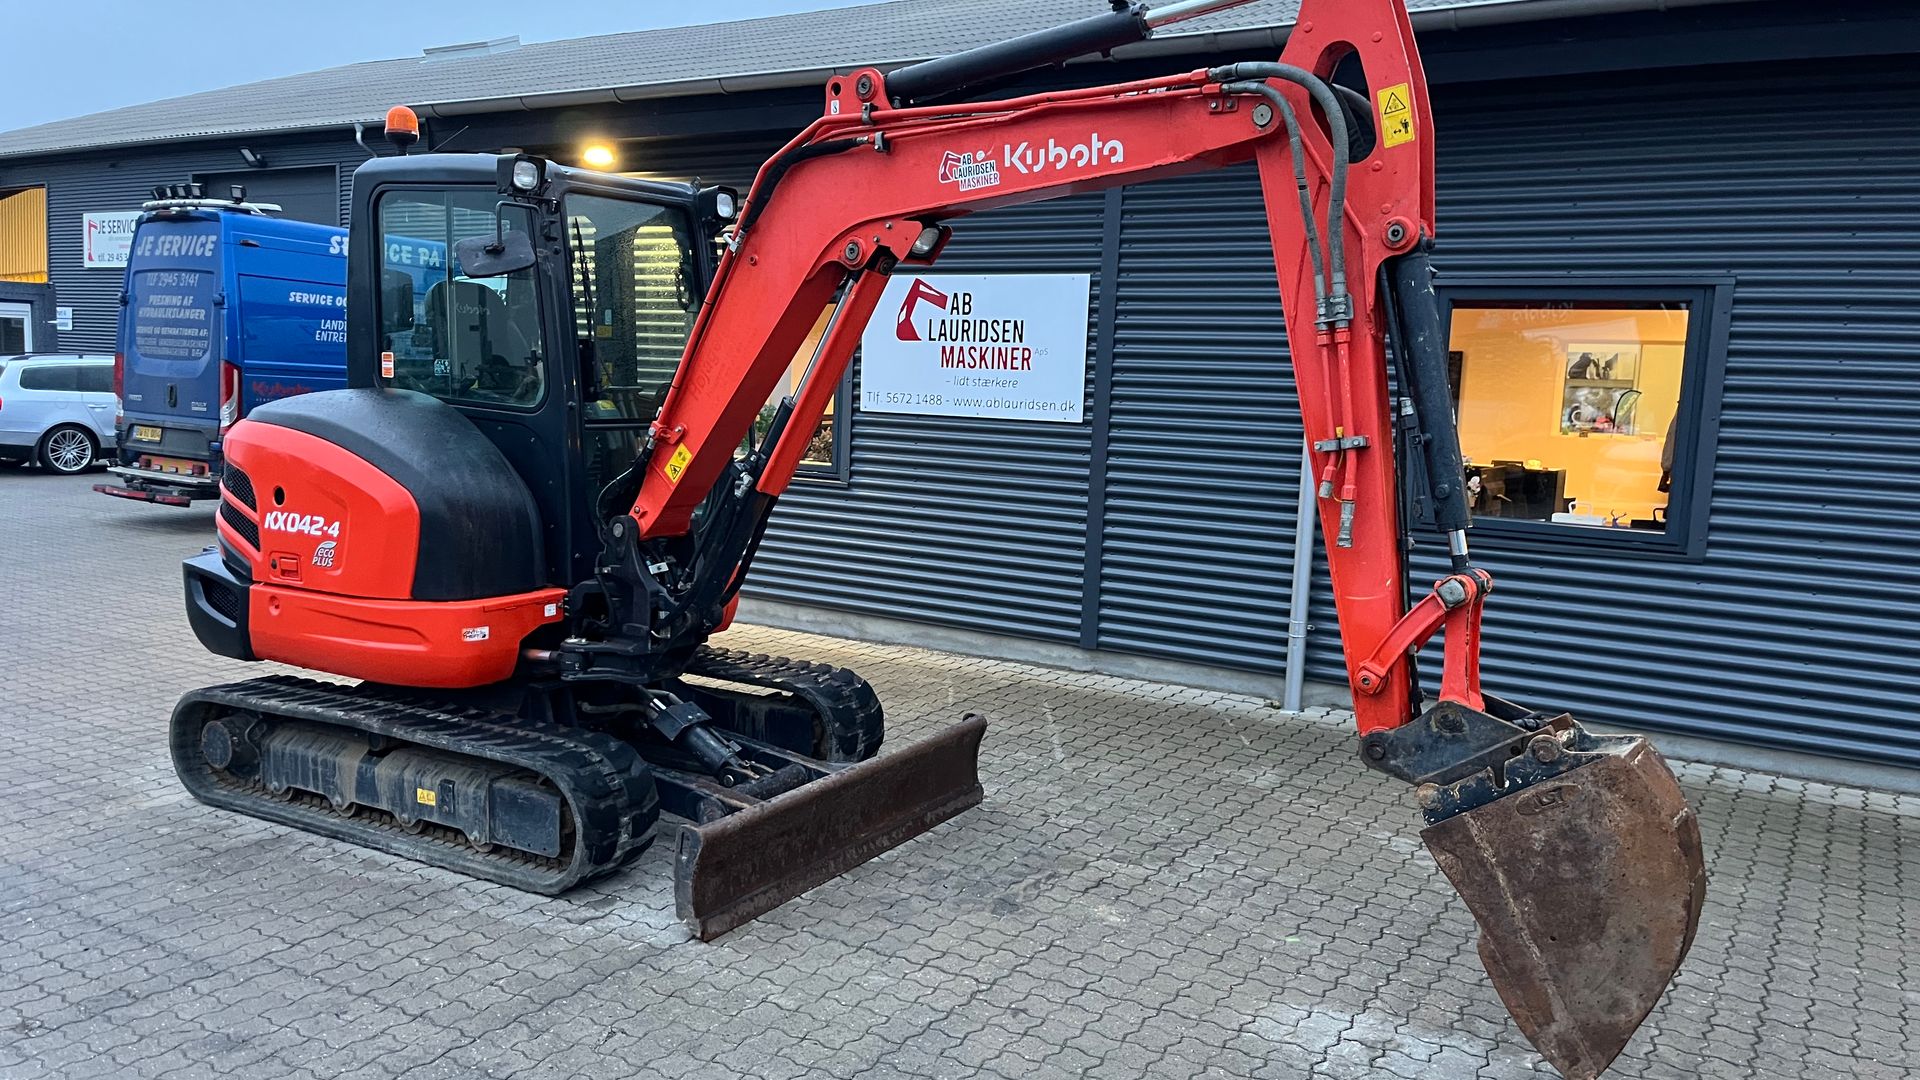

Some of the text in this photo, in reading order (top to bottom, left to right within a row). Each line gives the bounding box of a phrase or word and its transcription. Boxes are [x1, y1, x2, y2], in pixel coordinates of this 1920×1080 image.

[962, 153, 972, 165] AB
[1004, 132, 1124, 174] Kubota
[953, 163, 995, 179] LAURIDSEN
[960, 173, 999, 190] MASKINER
[98, 219, 136, 234] JE SERVIC
[137, 235, 217, 257] JE SERVICE
[159, 272, 179, 288] 2945
[179, 272, 200, 288] 3141
[182, 295, 194, 307] AF
[289, 291, 333, 306] SERVICE
[950, 293, 972, 316] AB
[928, 319, 1024, 344] LAURIDSEN
[940, 346, 1049, 371] MASKINER ApS
[953, 376, 970, 387] lidt
[972, 377, 1018, 389] stærkere
[867, 391, 883, 404] Tlf.
[886, 392, 912, 405] 5672
[916, 394, 943, 406] 1488
[953, 396, 1076, 413] www.ablauridsen.dk
[318, 548, 335, 558] eco
[312, 556, 333, 567] PLUS
